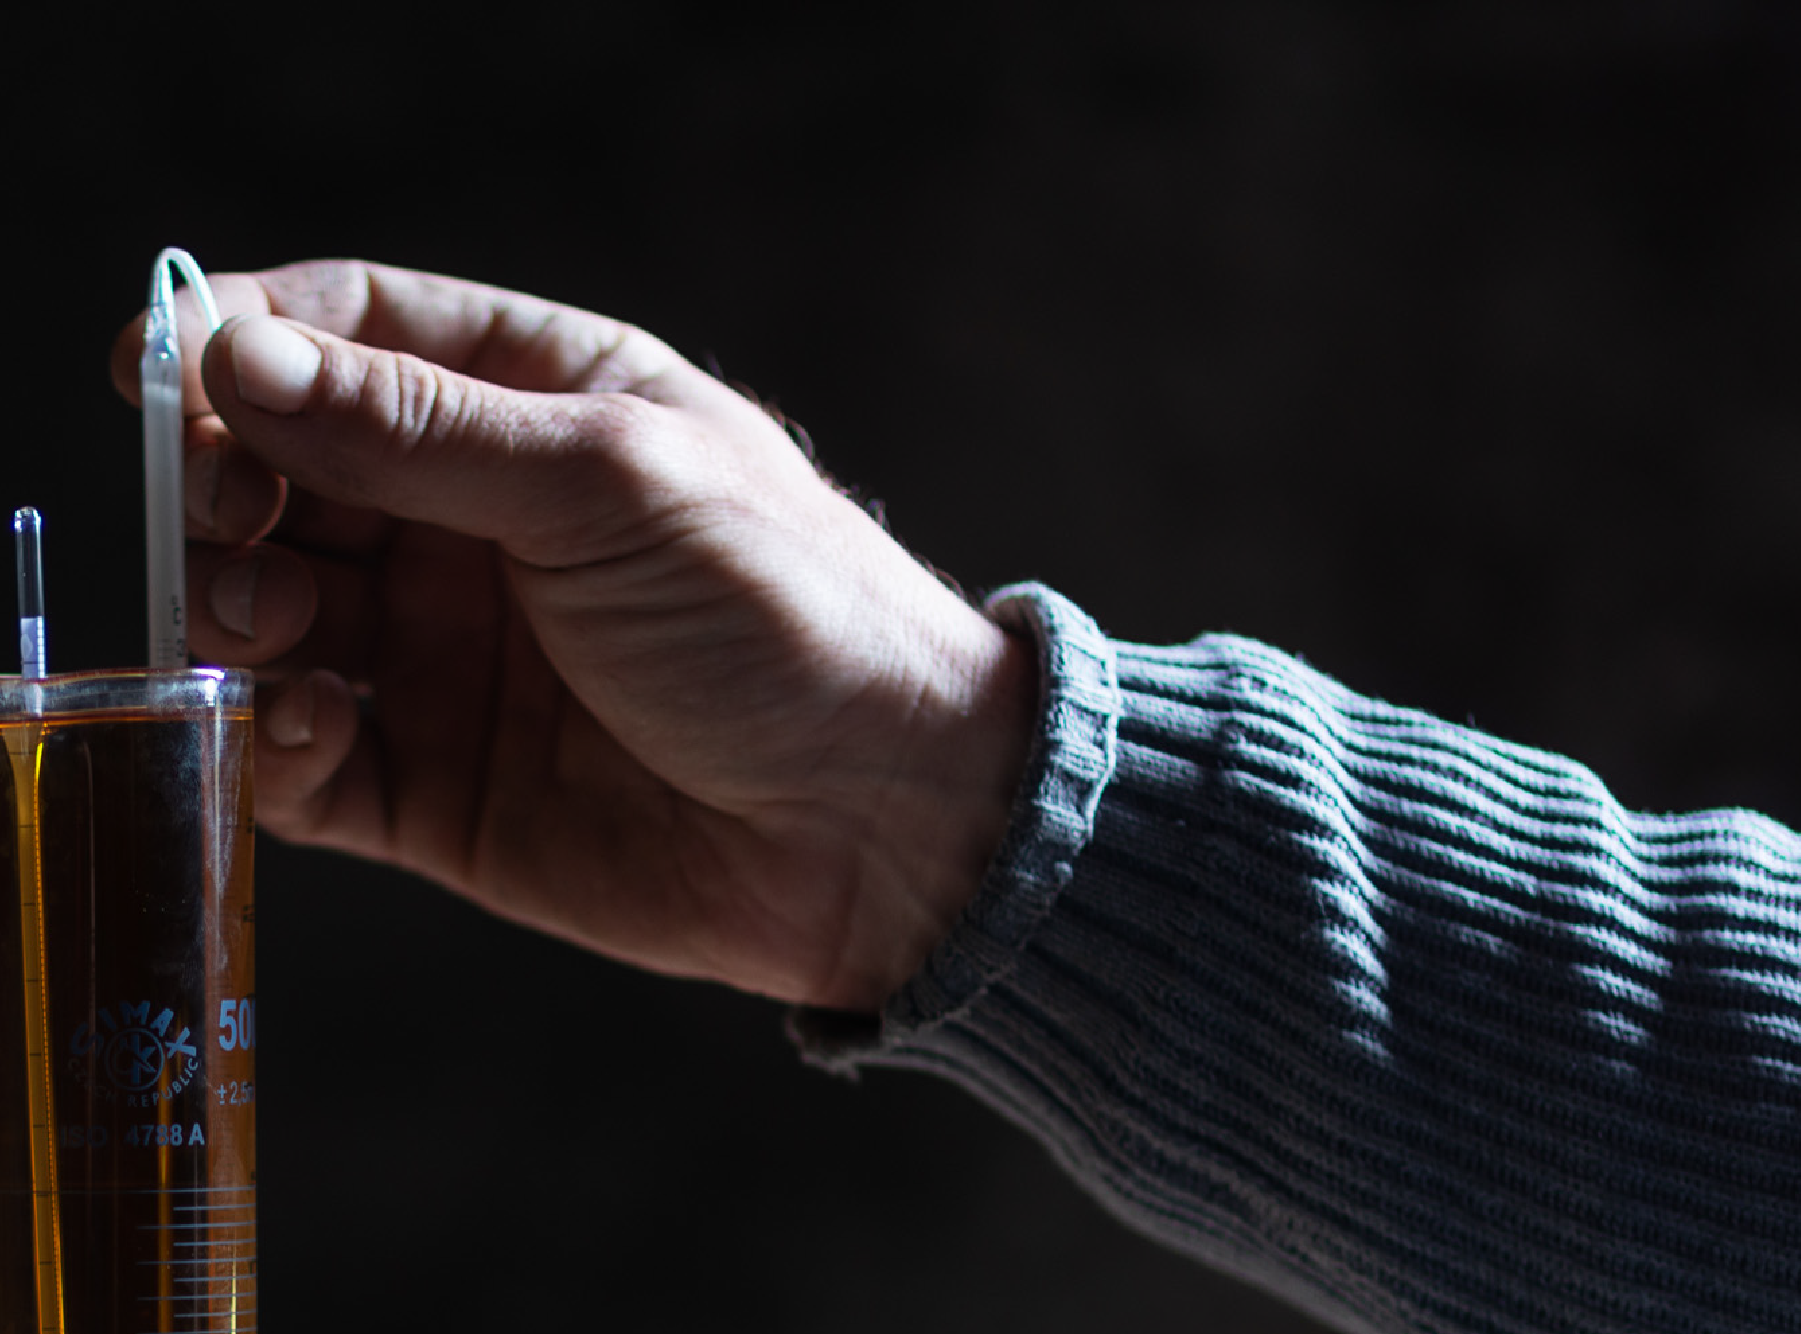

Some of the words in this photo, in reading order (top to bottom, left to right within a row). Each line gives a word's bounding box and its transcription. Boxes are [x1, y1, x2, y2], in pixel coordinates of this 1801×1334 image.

[70, 1000, 198, 1059] SIMAX
[127, 1057, 199, 1107] REPUBLIC
[60, 1123, 108, 1147] ISO
[124, 1123, 183, 1147] 4788
[188, 1122, 206, 1146] A
